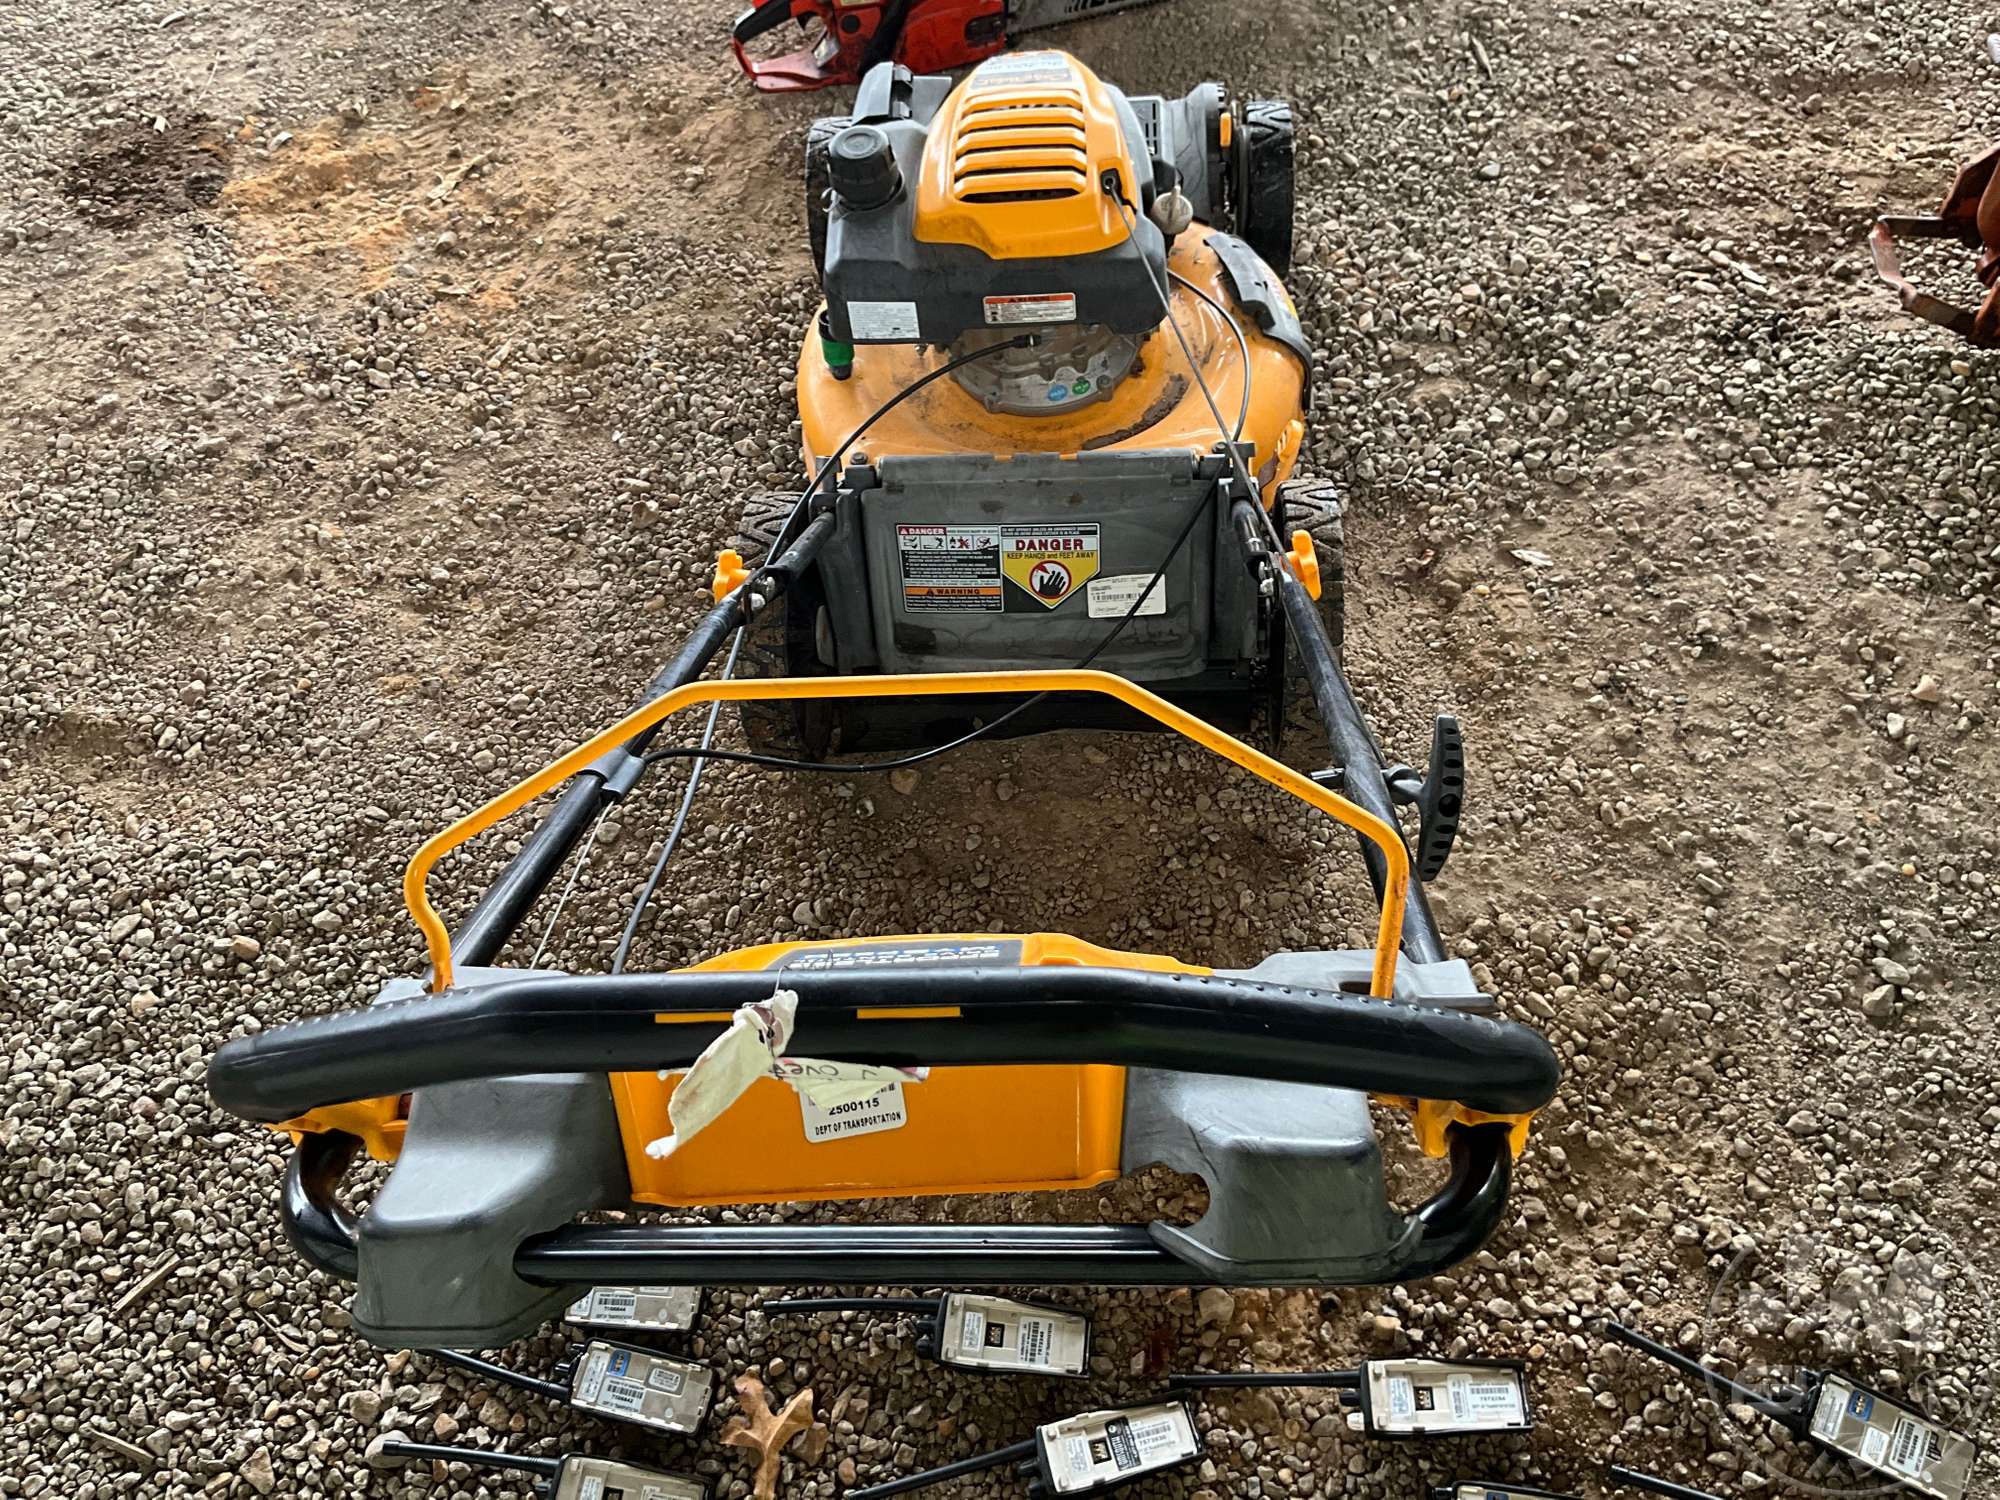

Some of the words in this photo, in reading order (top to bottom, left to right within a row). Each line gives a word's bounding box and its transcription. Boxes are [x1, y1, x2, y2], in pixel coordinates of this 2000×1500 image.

[1015, 538, 1084, 551] DANGER
[1007, 552, 1023, 560] KEEP
[1075, 551, 1095, 559] AWAY
[828, 1098, 880, 1116] 2500115
[815, 1124, 832, 1136] DEPT
[833, 1122, 842, 1133] OF
[843, 1111, 902, 1130] TRANSPORTATION
